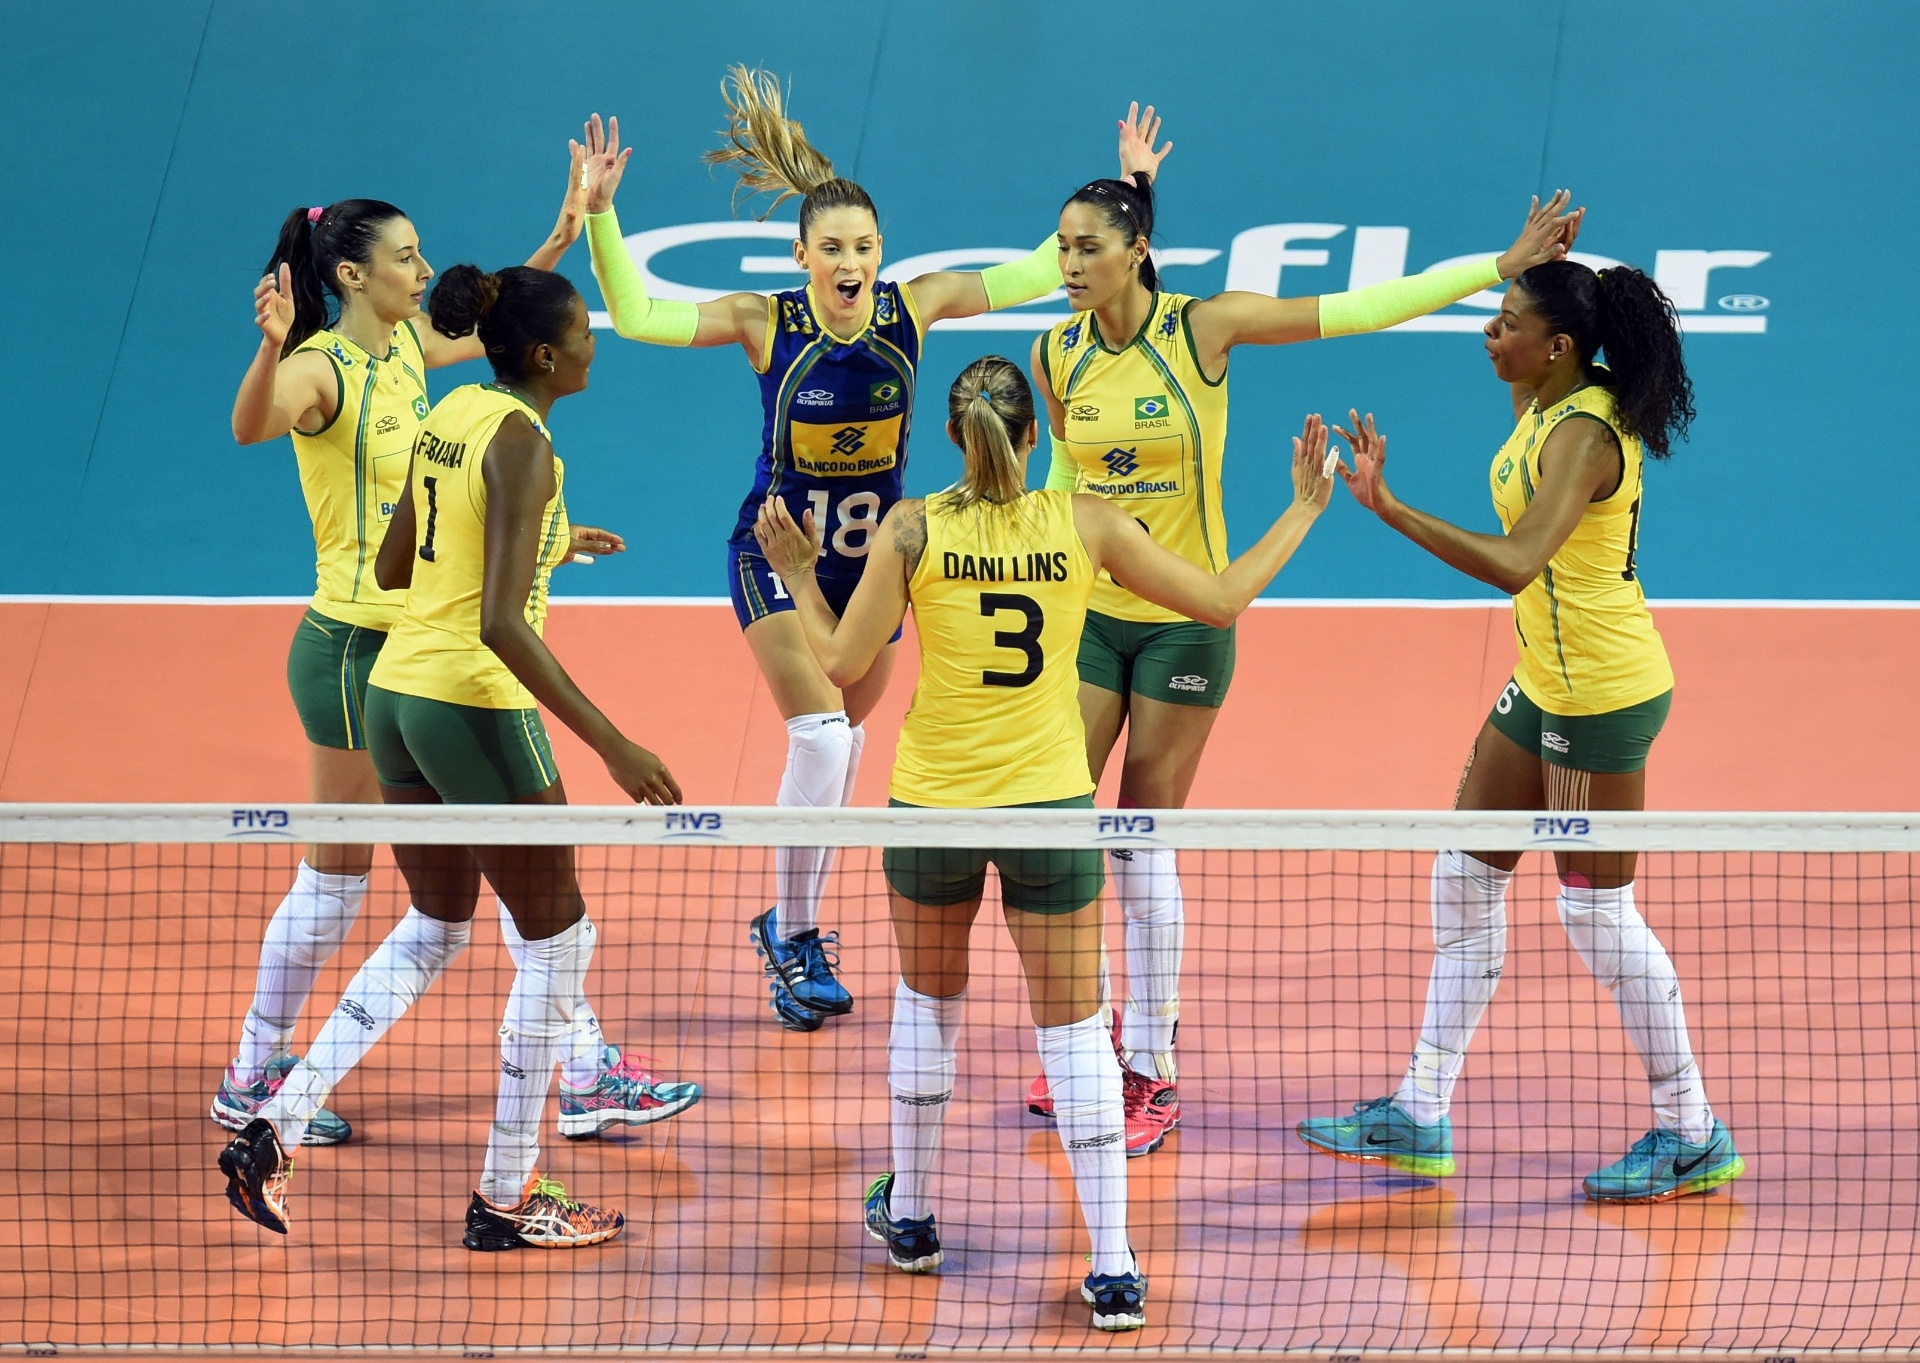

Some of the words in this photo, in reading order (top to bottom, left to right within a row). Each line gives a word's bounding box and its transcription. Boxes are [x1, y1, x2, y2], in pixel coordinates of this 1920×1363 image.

[797, 398, 834, 406] OLYMPIKUS
[869, 401, 901, 413] BRASIL
[1134, 419, 1171, 430] BRASIL
[798, 456, 838, 473] BANCO
[839, 462, 856, 472] DO
[857, 454, 894, 472] BRASIL
[1117, 483, 1135, 495] DO
[1135, 480, 1179, 494] BRASIL
[419, 475, 438, 563] 1
[806, 489, 881, 558] 18
[943, 551, 1004, 582] DANI
[1012, 551, 1068, 582] LINS
[980, 592, 1045, 688] 3
[1168, 682, 1207, 693] OLYMPIKUS
[231, 809, 290, 828] FIVB
[664, 812, 722, 830] FIVB
[1098, 815, 1155, 833] FIVB
[1533, 817, 1590, 835] FIVB
